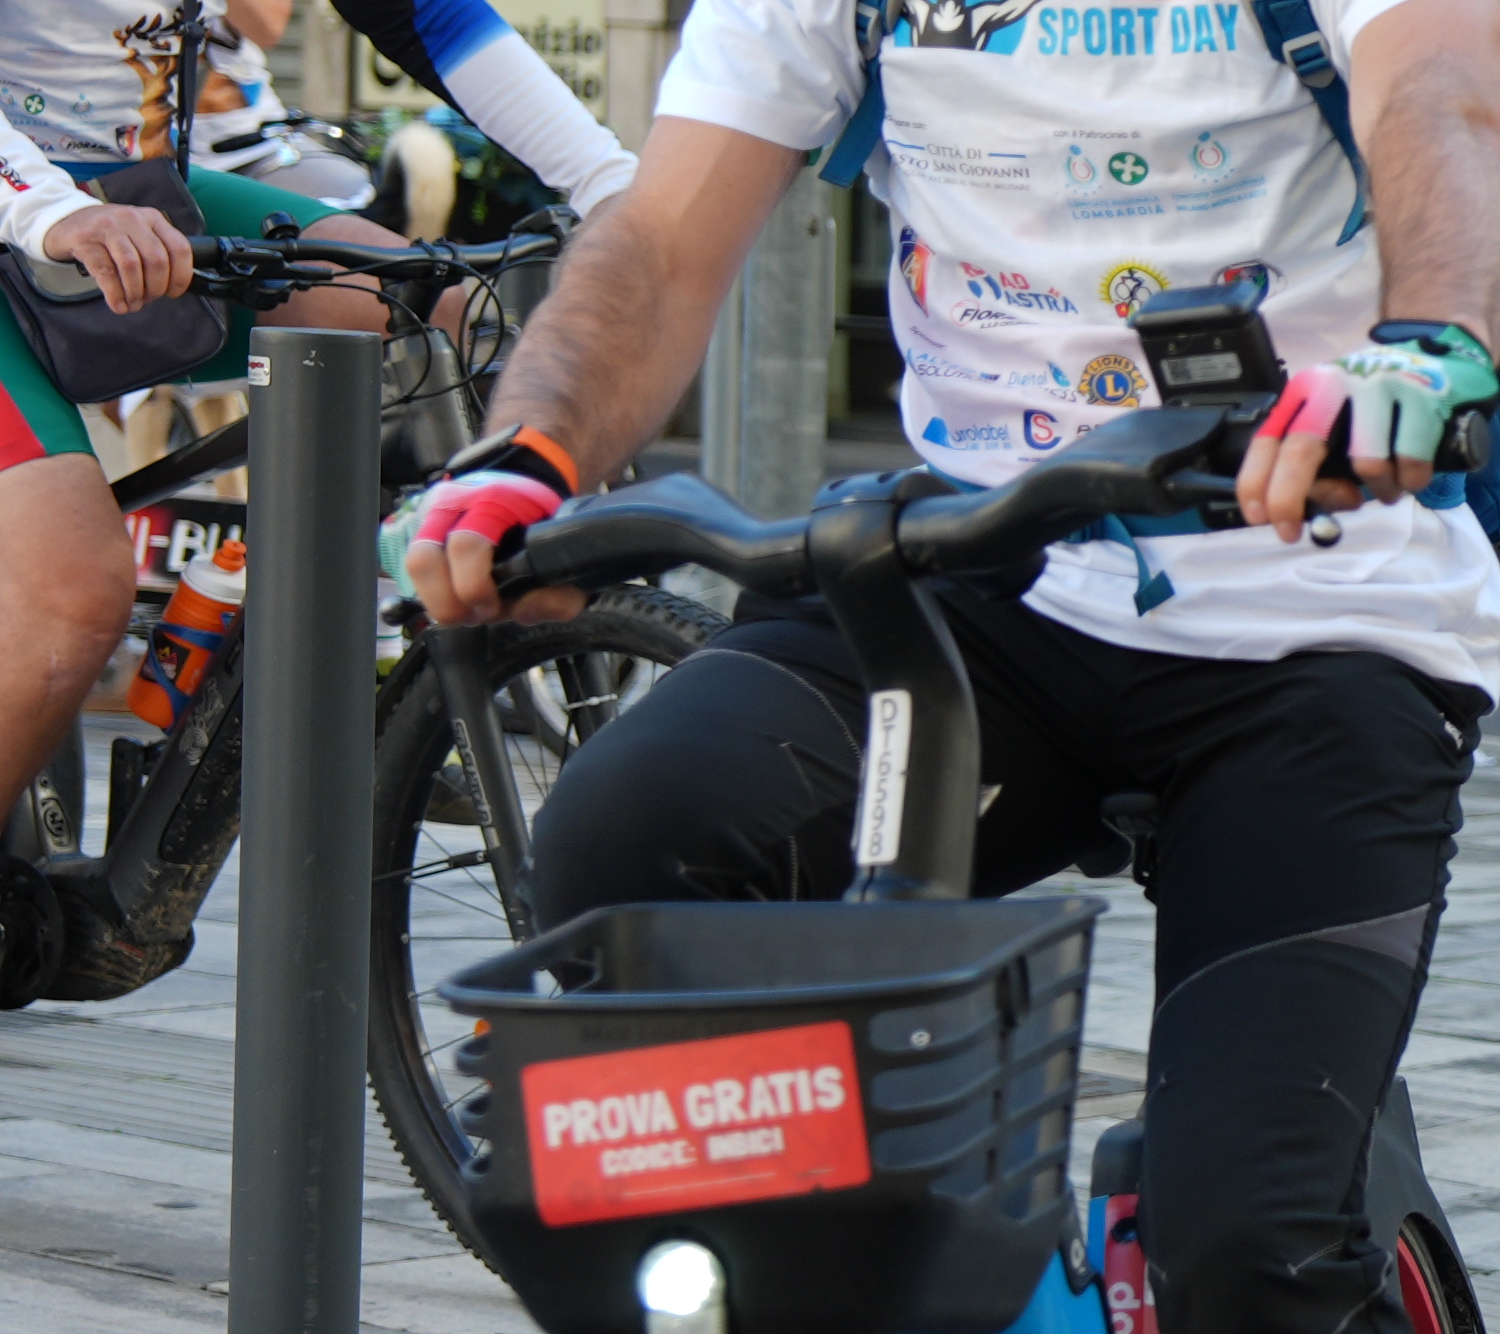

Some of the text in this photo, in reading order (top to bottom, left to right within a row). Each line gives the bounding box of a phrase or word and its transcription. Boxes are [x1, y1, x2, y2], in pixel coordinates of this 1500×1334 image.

[1037, 5, 1239, 57] SPORT DAY
[966, 147, 982, 161] DI
[958, 161, 1031, 180] GIOVANNI
[1071, 204, 1166, 221] LOMBARDIA
[544, 1064, 848, 1150] PROVA GRATIS
